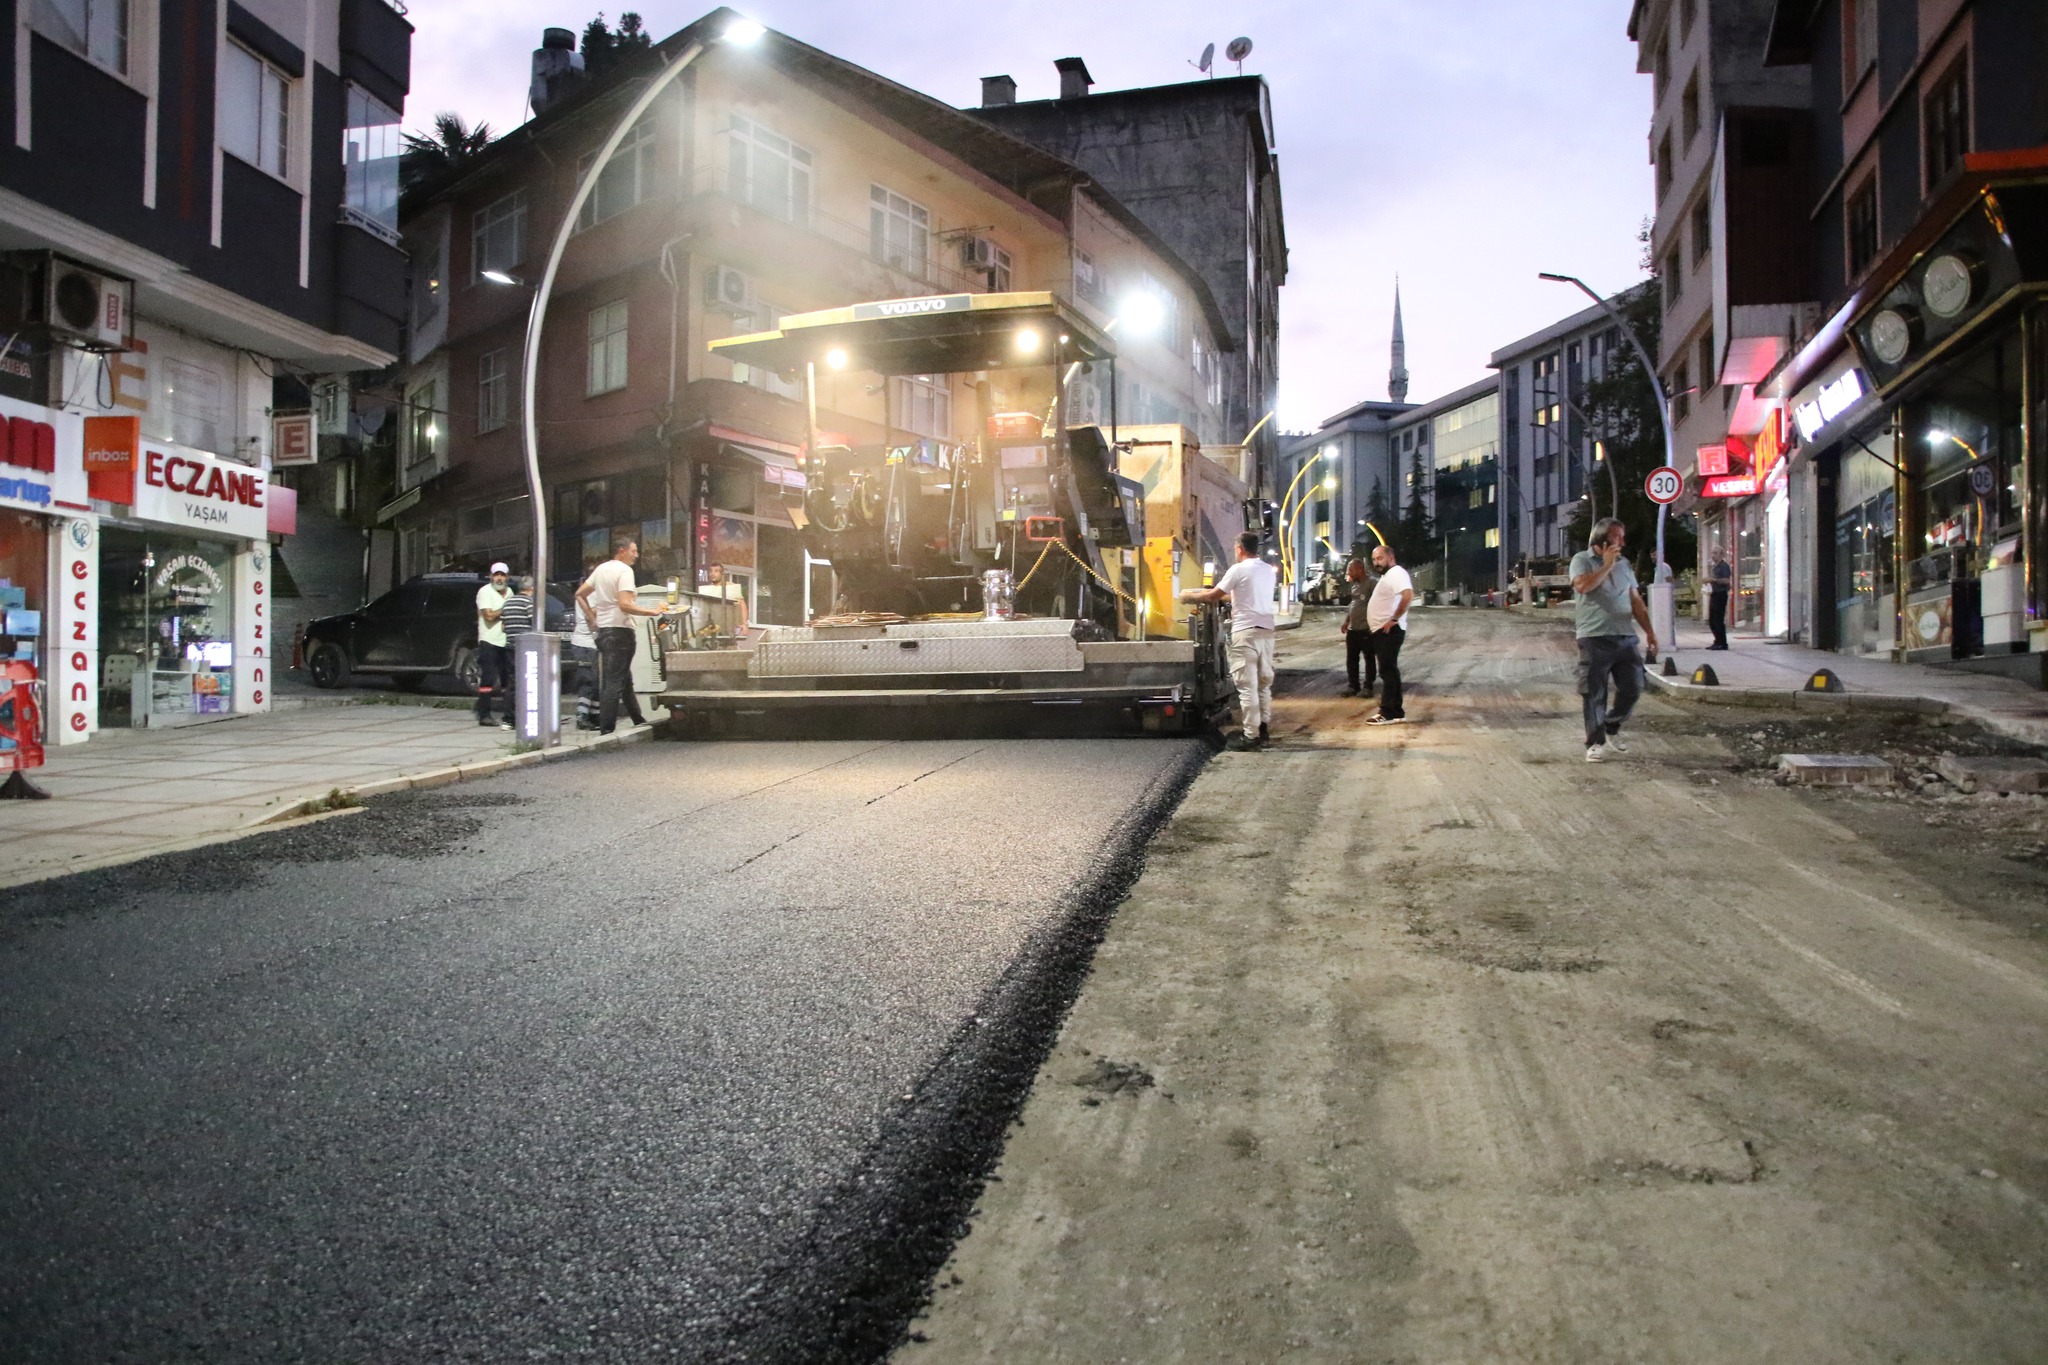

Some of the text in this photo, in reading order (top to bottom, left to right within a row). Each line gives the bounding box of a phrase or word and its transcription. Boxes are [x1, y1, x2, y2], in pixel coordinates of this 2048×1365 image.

[878, 299, 946, 315] VOLVO
[284, 425, 305, 455] E
[88, 448, 129, 462] inbox
[146, 450, 263, 508] ECZANE
[1654, 477, 1675, 494] 30
[1710, 480, 1756, 493] VESTEL
[185, 502, 228, 524] YAŞAM
[70, 560, 88, 732] eczane
